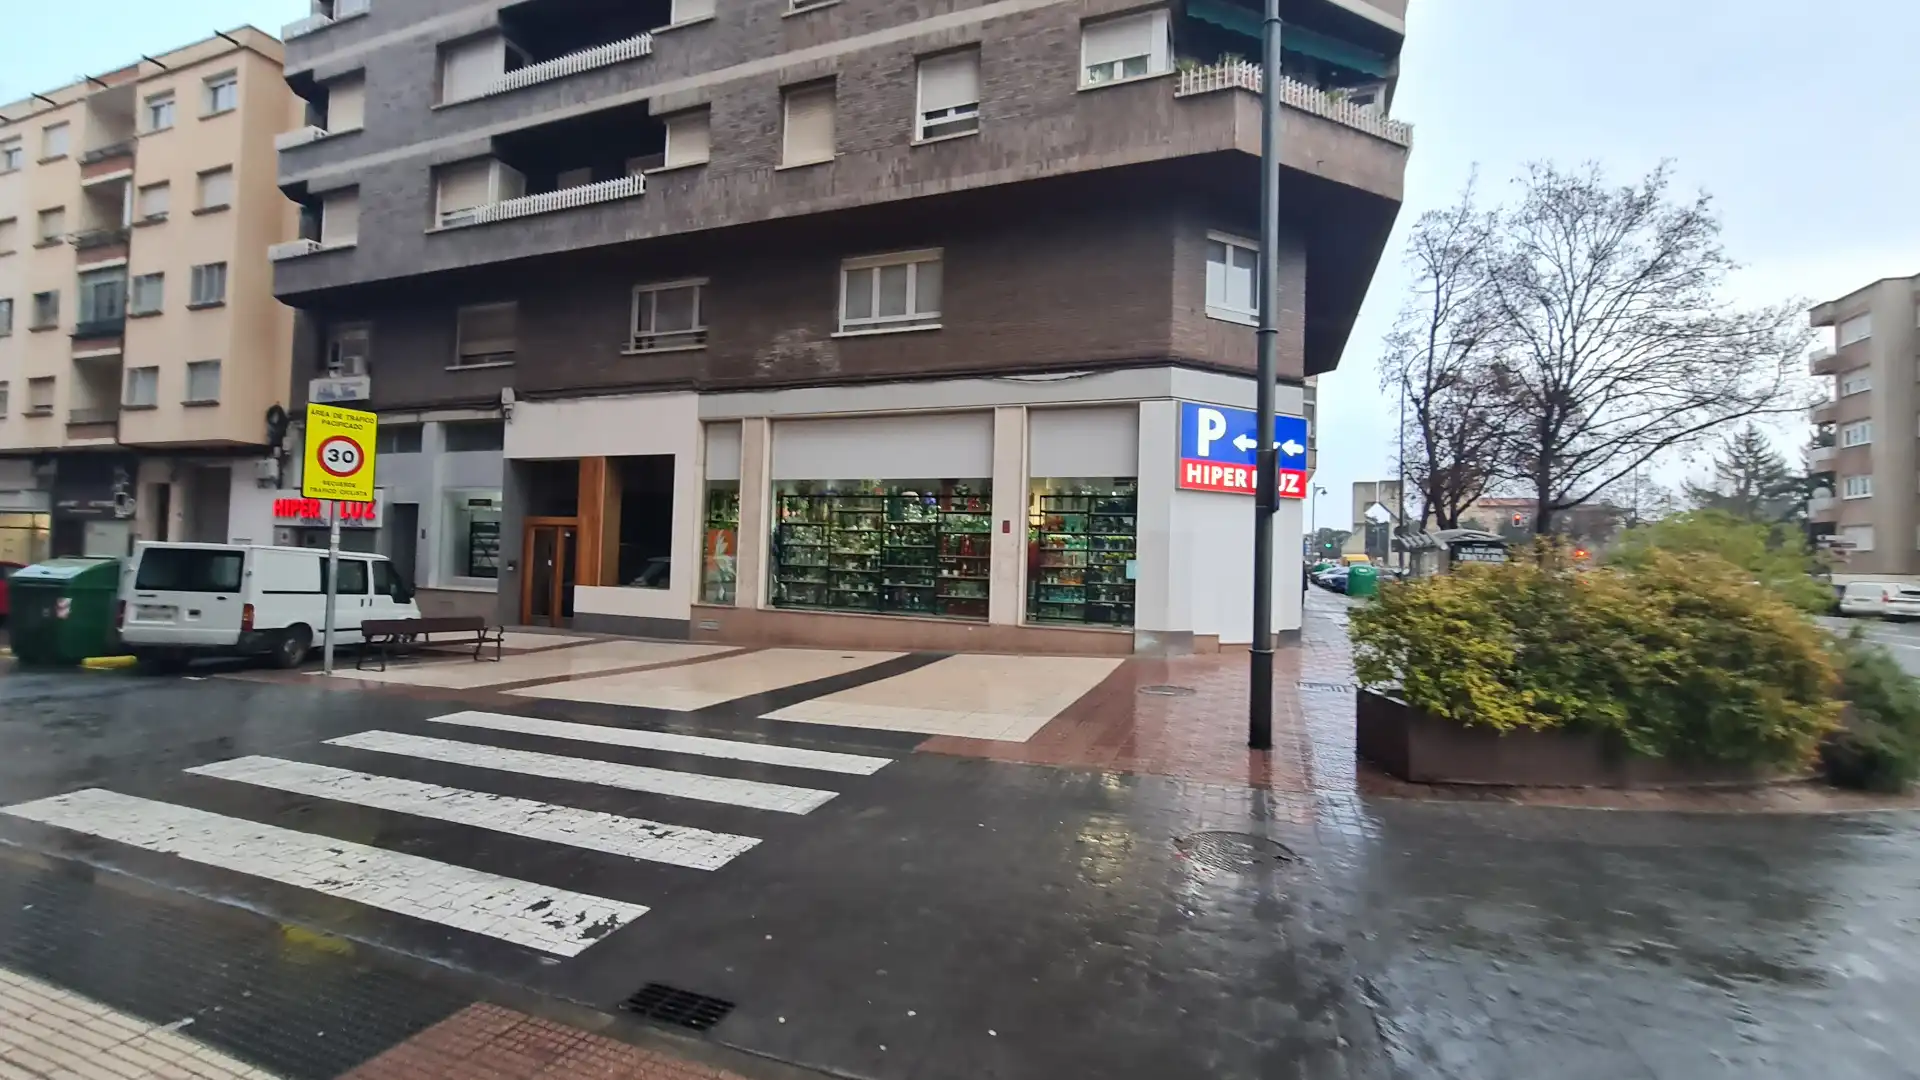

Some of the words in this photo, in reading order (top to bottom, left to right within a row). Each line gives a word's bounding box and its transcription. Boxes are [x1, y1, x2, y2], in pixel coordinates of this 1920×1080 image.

[332, 412, 343, 420] DE
[321, 419, 364, 430] PACIFICADO
[1197, 407, 1227, 457] P
[327, 448, 355, 464] 30
[1186, 463, 1247, 489] HIPER
[339, 489, 368, 497] CICLISTA
[273, 498, 321, 518] HIPER
[340, 500, 376, 519] LUZ
